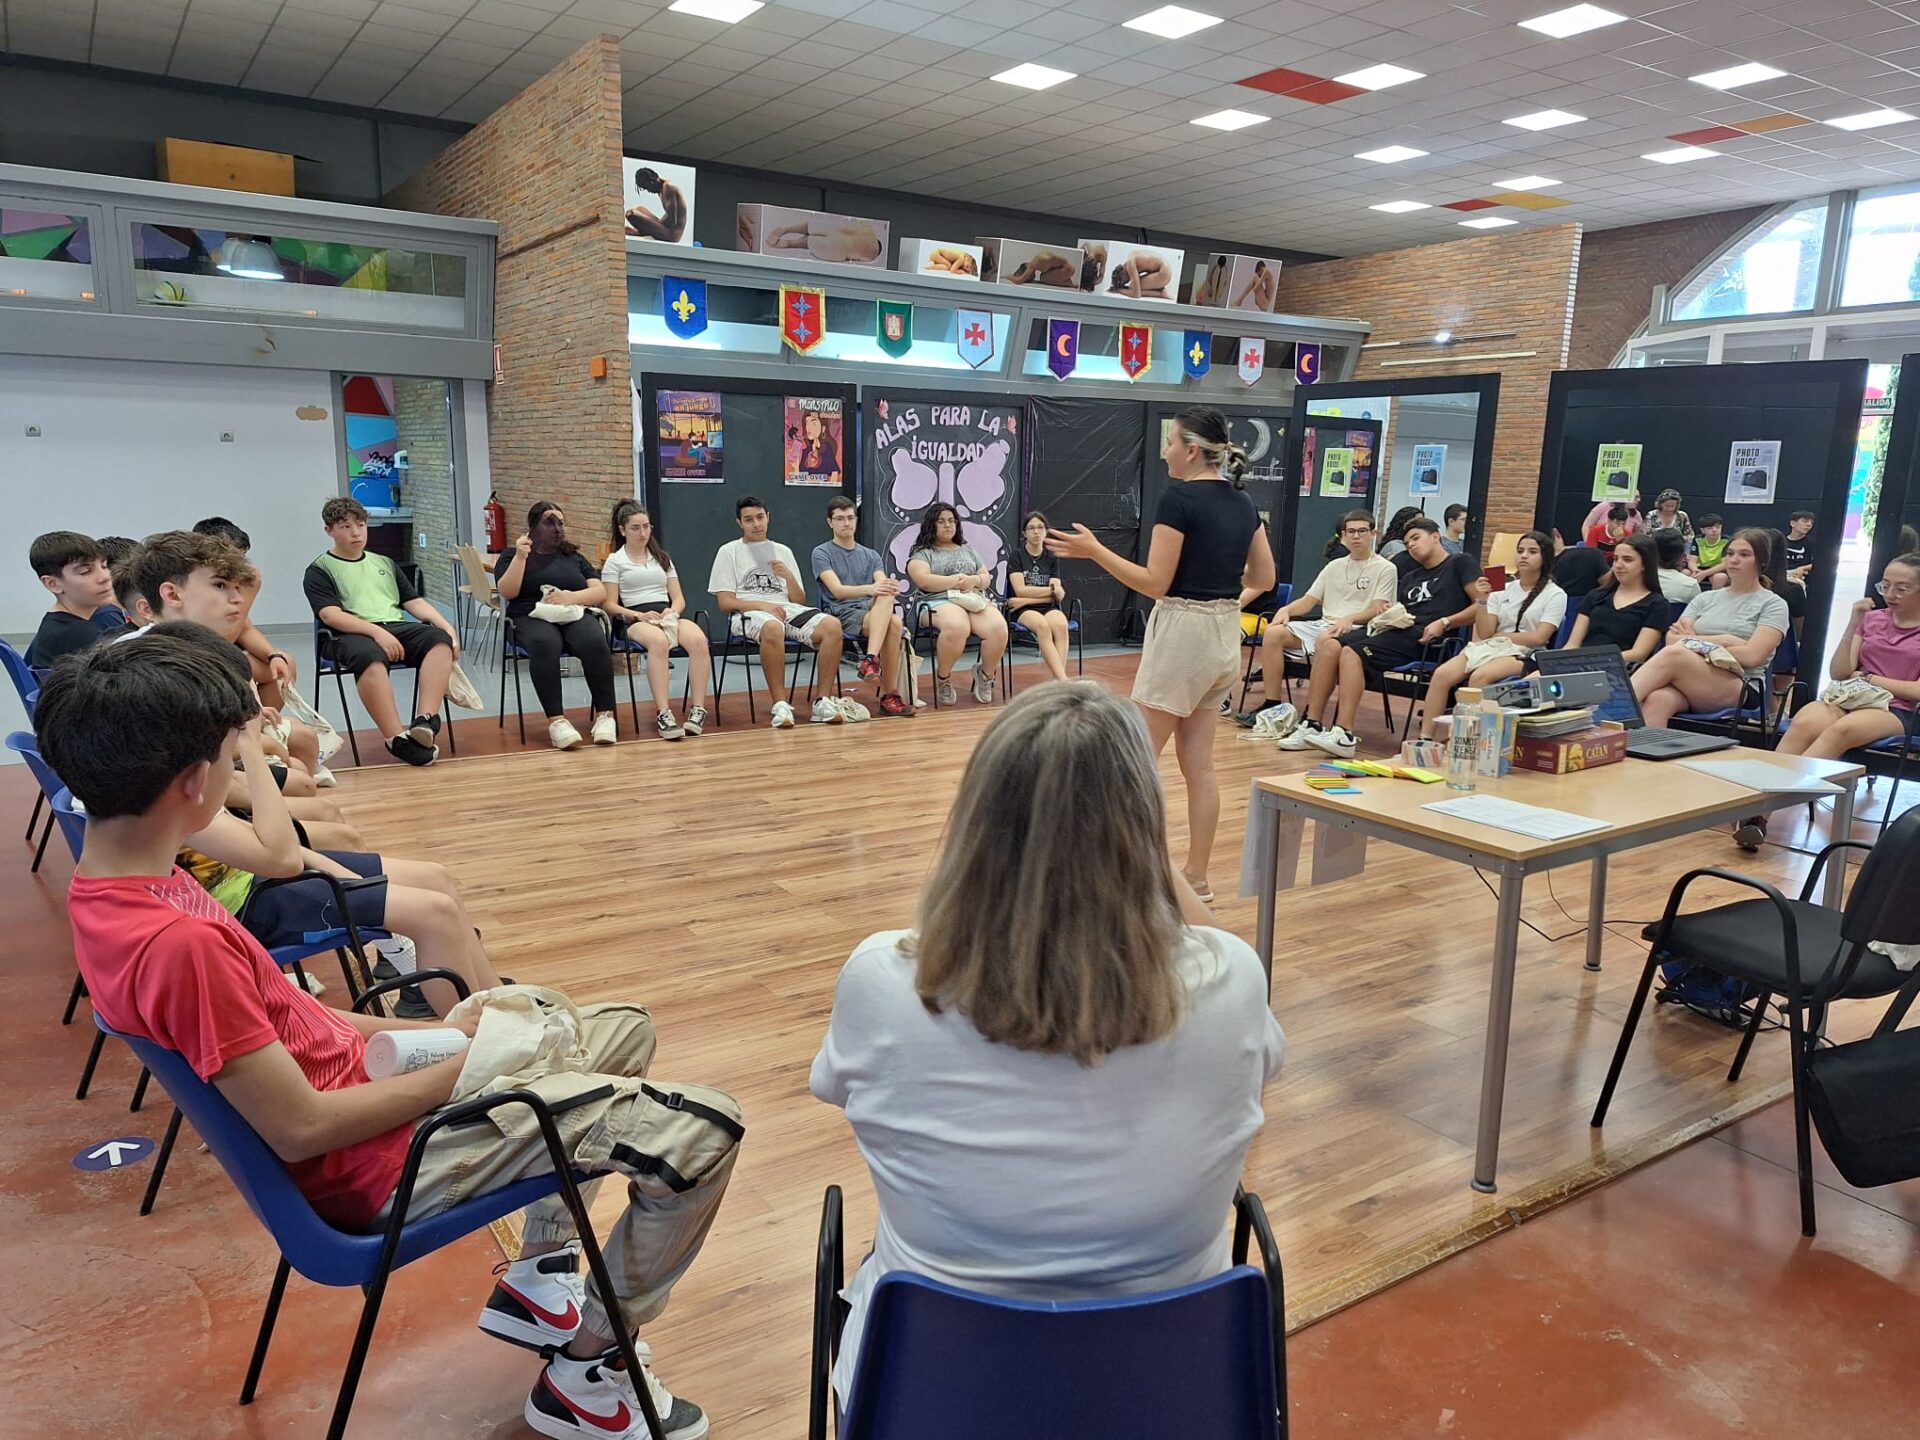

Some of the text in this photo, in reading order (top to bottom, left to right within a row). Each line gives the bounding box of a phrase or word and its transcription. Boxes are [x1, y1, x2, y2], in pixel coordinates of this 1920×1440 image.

[875, 405, 1001, 449] ALAS PARA LA
[1416, 450, 1433, 459] PHOTO
[1602, 450, 1624, 459] PHOTO
[1736, 448, 1760, 457] PHOTO
[1416, 458, 1431, 466] VOICE
[1602, 459, 1620, 468] VOICE
[1735, 457, 1757, 467] VOICE
[1454, 736, 1478, 746] SOMOS
[1585, 744, 1609, 759] CATAN
